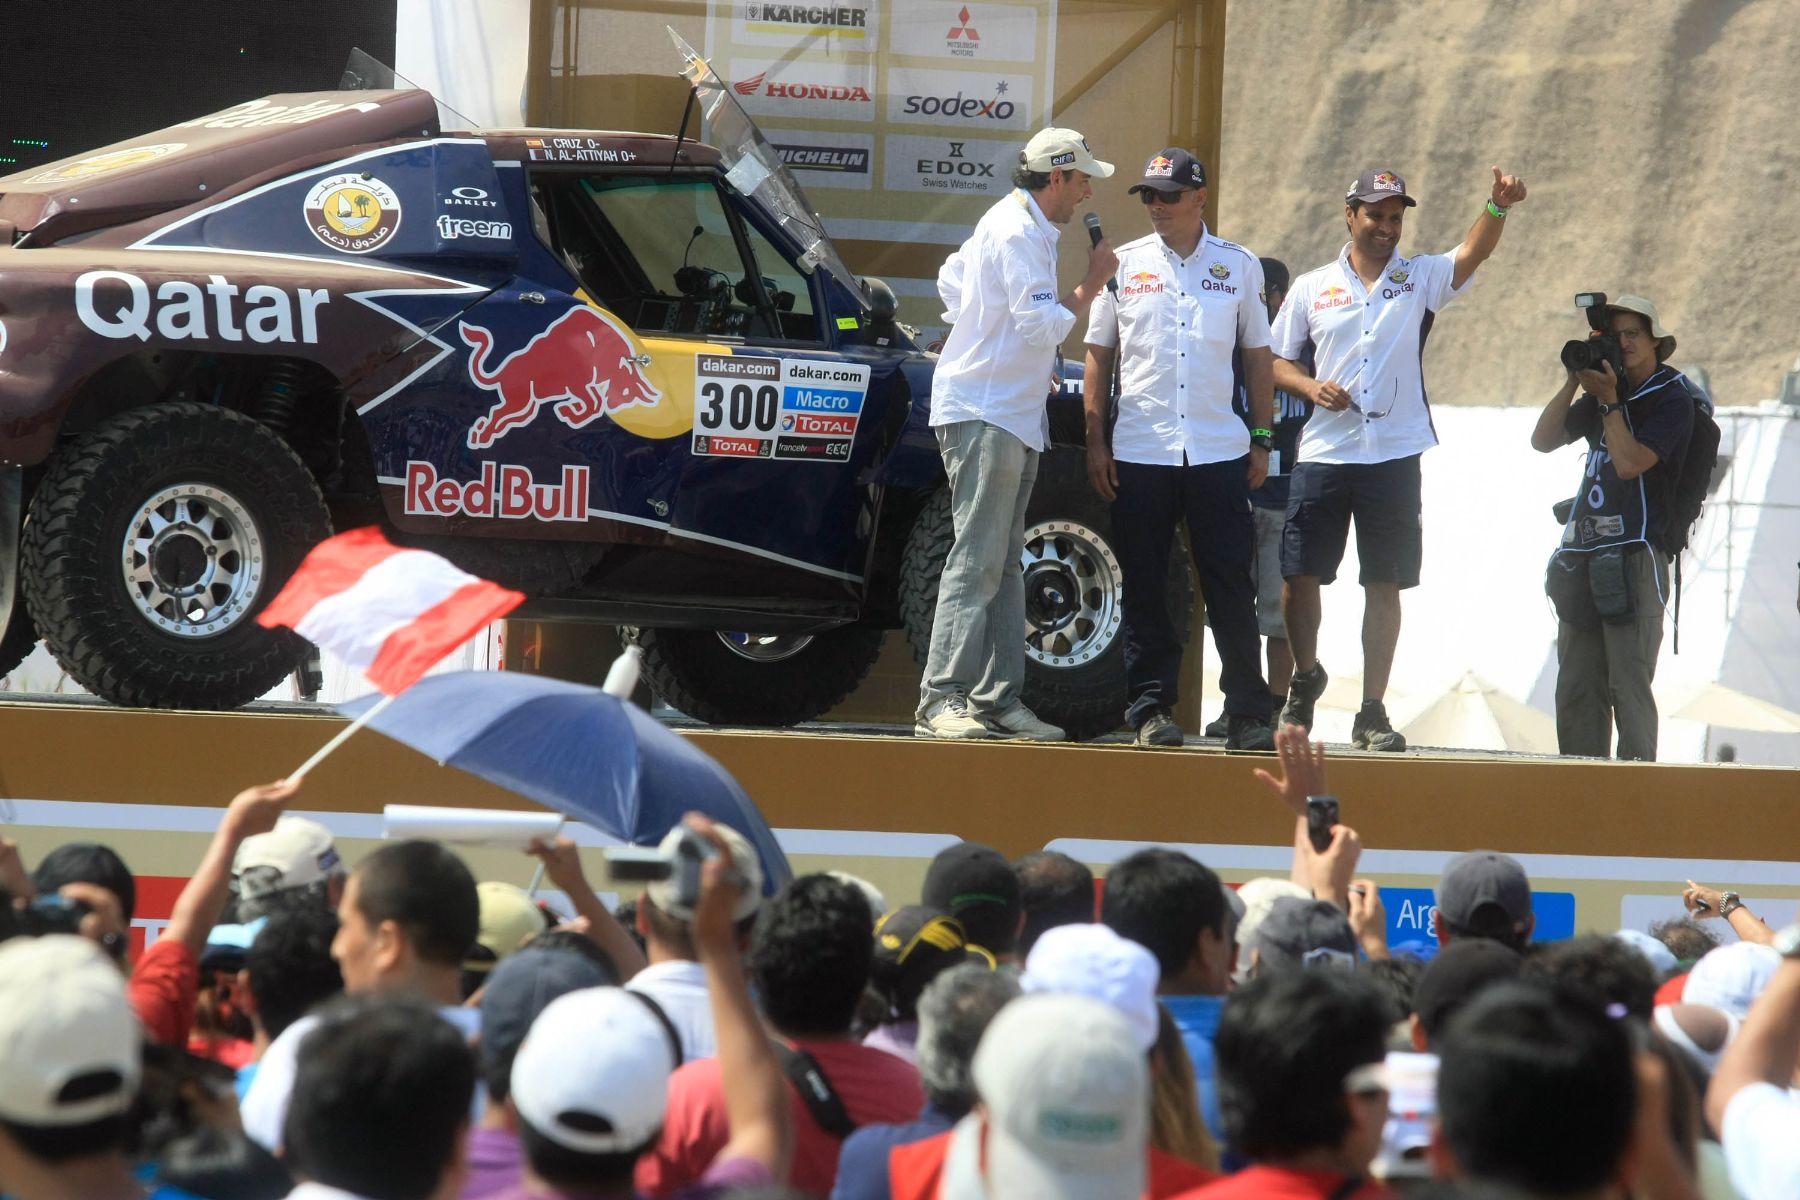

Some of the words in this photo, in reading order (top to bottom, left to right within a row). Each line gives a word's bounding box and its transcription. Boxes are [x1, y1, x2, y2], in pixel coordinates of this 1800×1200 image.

[765, 82, 871, 101] HONDA
[903, 91, 1015, 120] sodexo
[553, 138, 583, 149] CRUZ
[559, 149, 618, 162] AL-ATTIYAH
[1052, 156, 1067, 165] elf
[917, 160, 995, 177] EDOX
[922, 178, 948, 188] Swiss
[950, 179, 988, 191] Watches
[444, 198, 497, 207] OAKLEY
[437, 215, 512, 239] freem
[1124, 284, 1144, 296] Red
[1144, 283, 1164, 294] Bull
[1201, 279, 1238, 296] Qatar
[1382, 282, 1415, 300] Qatar
[75, 270, 330, 344] Qatar
[1314, 298, 1333, 312] Red
[1333, 296, 1352, 307] Bull
[702, 358, 776, 376] dakar.com
[789, 365, 862, 383] dakar.com
[700, 382, 779, 432] 300
[795, 390, 849, 410] Macro
[405, 460, 497, 517] Red
[498, 464, 590, 523] Bull
